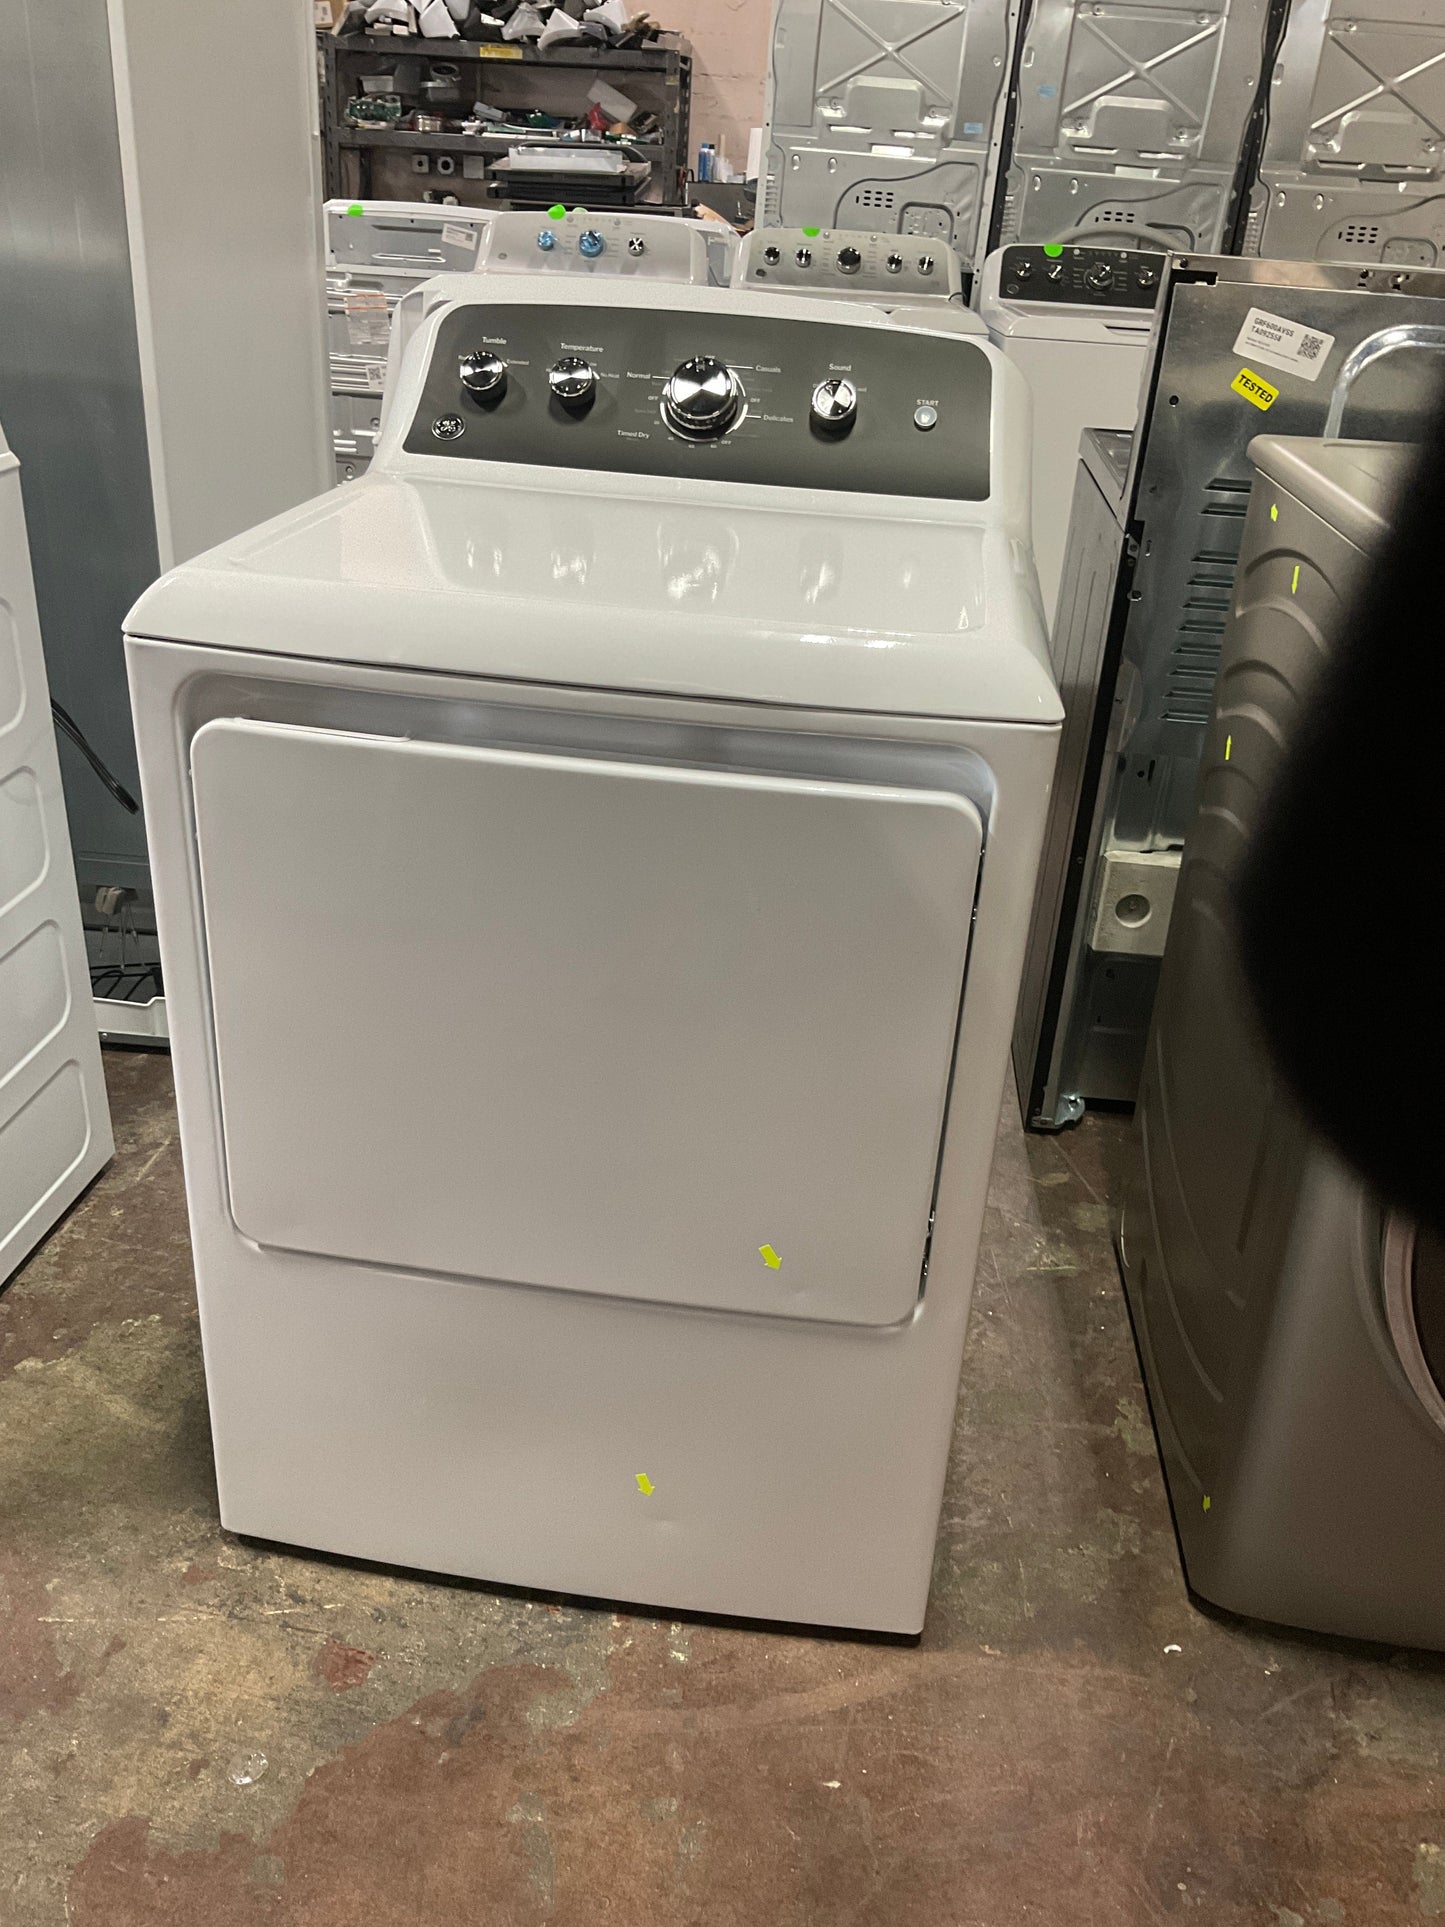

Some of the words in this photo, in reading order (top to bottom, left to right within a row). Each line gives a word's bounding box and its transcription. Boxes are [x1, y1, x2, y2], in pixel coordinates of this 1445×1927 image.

[482, 336, 507, 345] Tumble
[560, 342, 604, 352] Temperature
[755, 364, 782, 373] Casuals
[828, 363, 852, 372] Sound
[626, 371, 651, 380] Normal
[1238, 374, 1273, 403] TESTED
[916, 399, 940, 407] START
[763, 414, 794, 423] Delicates
[617, 429, 638, 438] Timed
[638, 431, 650, 440] Dry
